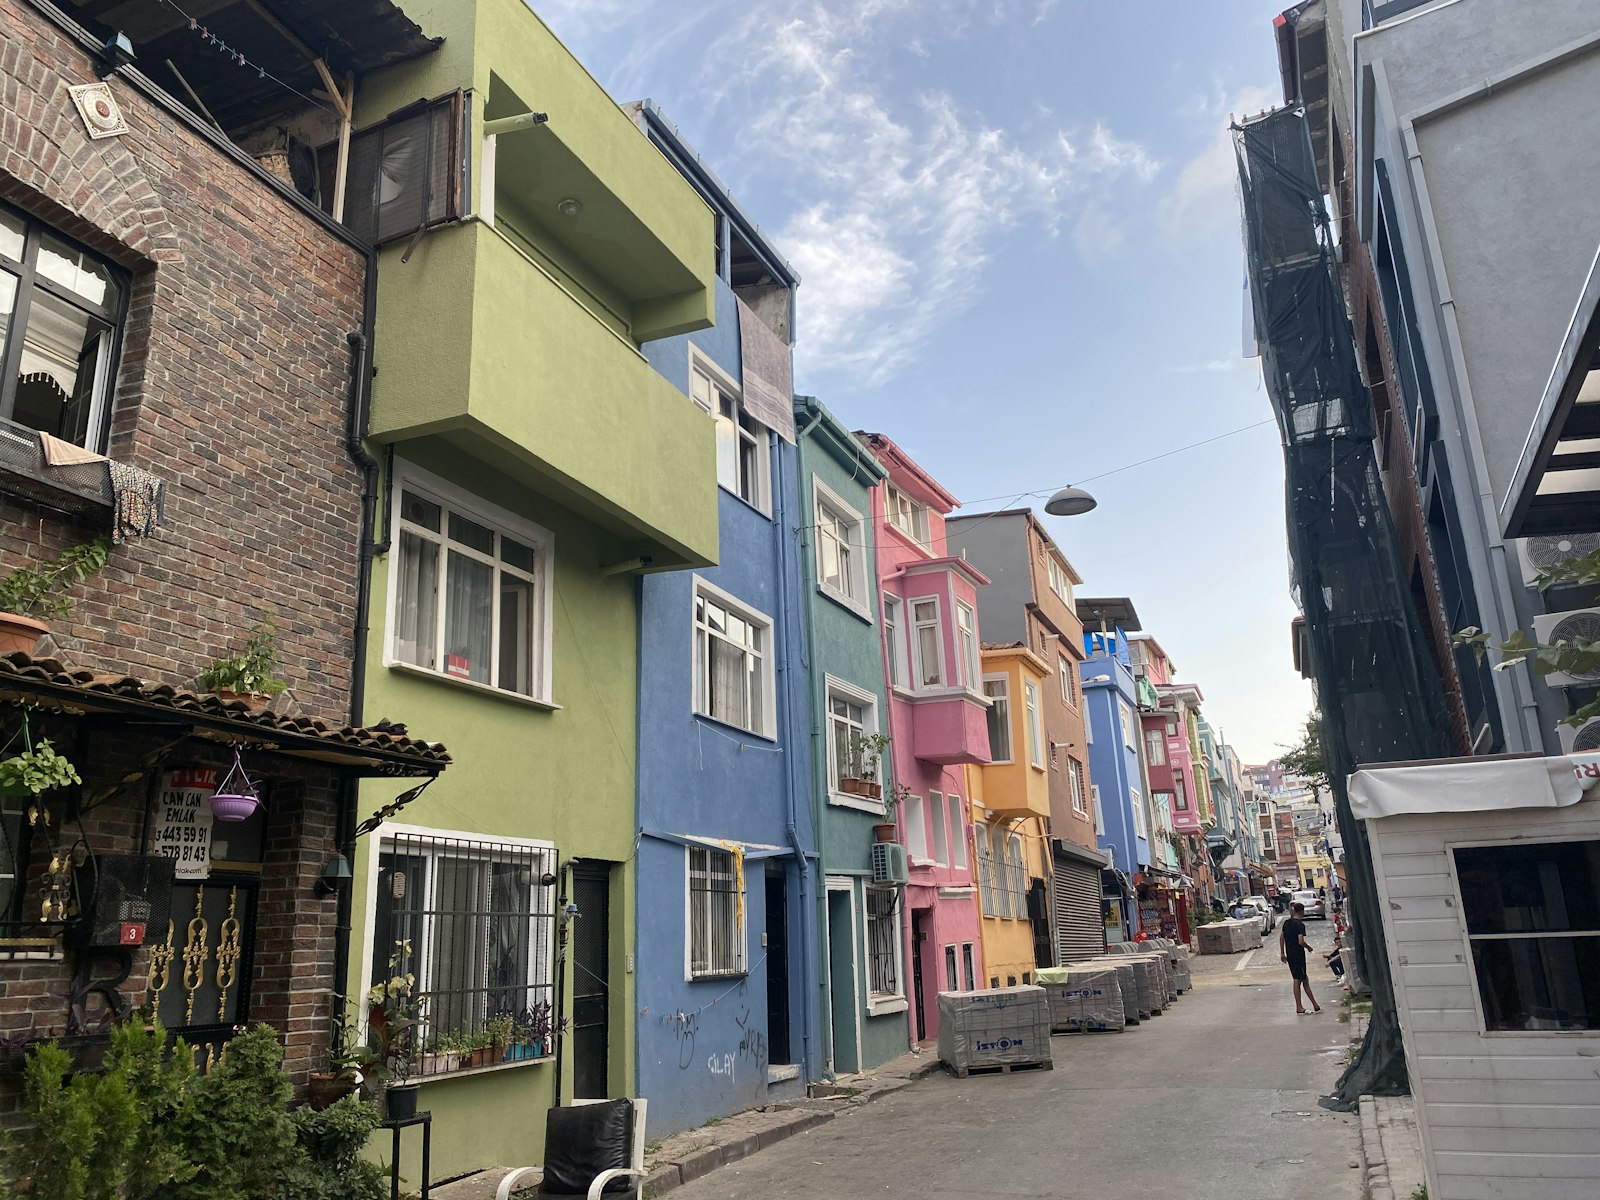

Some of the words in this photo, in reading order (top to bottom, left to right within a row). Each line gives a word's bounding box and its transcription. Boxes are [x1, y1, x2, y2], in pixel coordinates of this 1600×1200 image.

[163, 791, 183, 806] CAN
[186, 793, 202, 807] CAN
[166, 808, 197, 823] EMLAK
[163, 826, 181, 842] 443
[184, 827, 196, 842] 59
[199, 827, 207, 843] 91
[183, 846, 193, 861] 81
[194, 847, 206, 862] 43
[130, 928, 136, 940] 3
